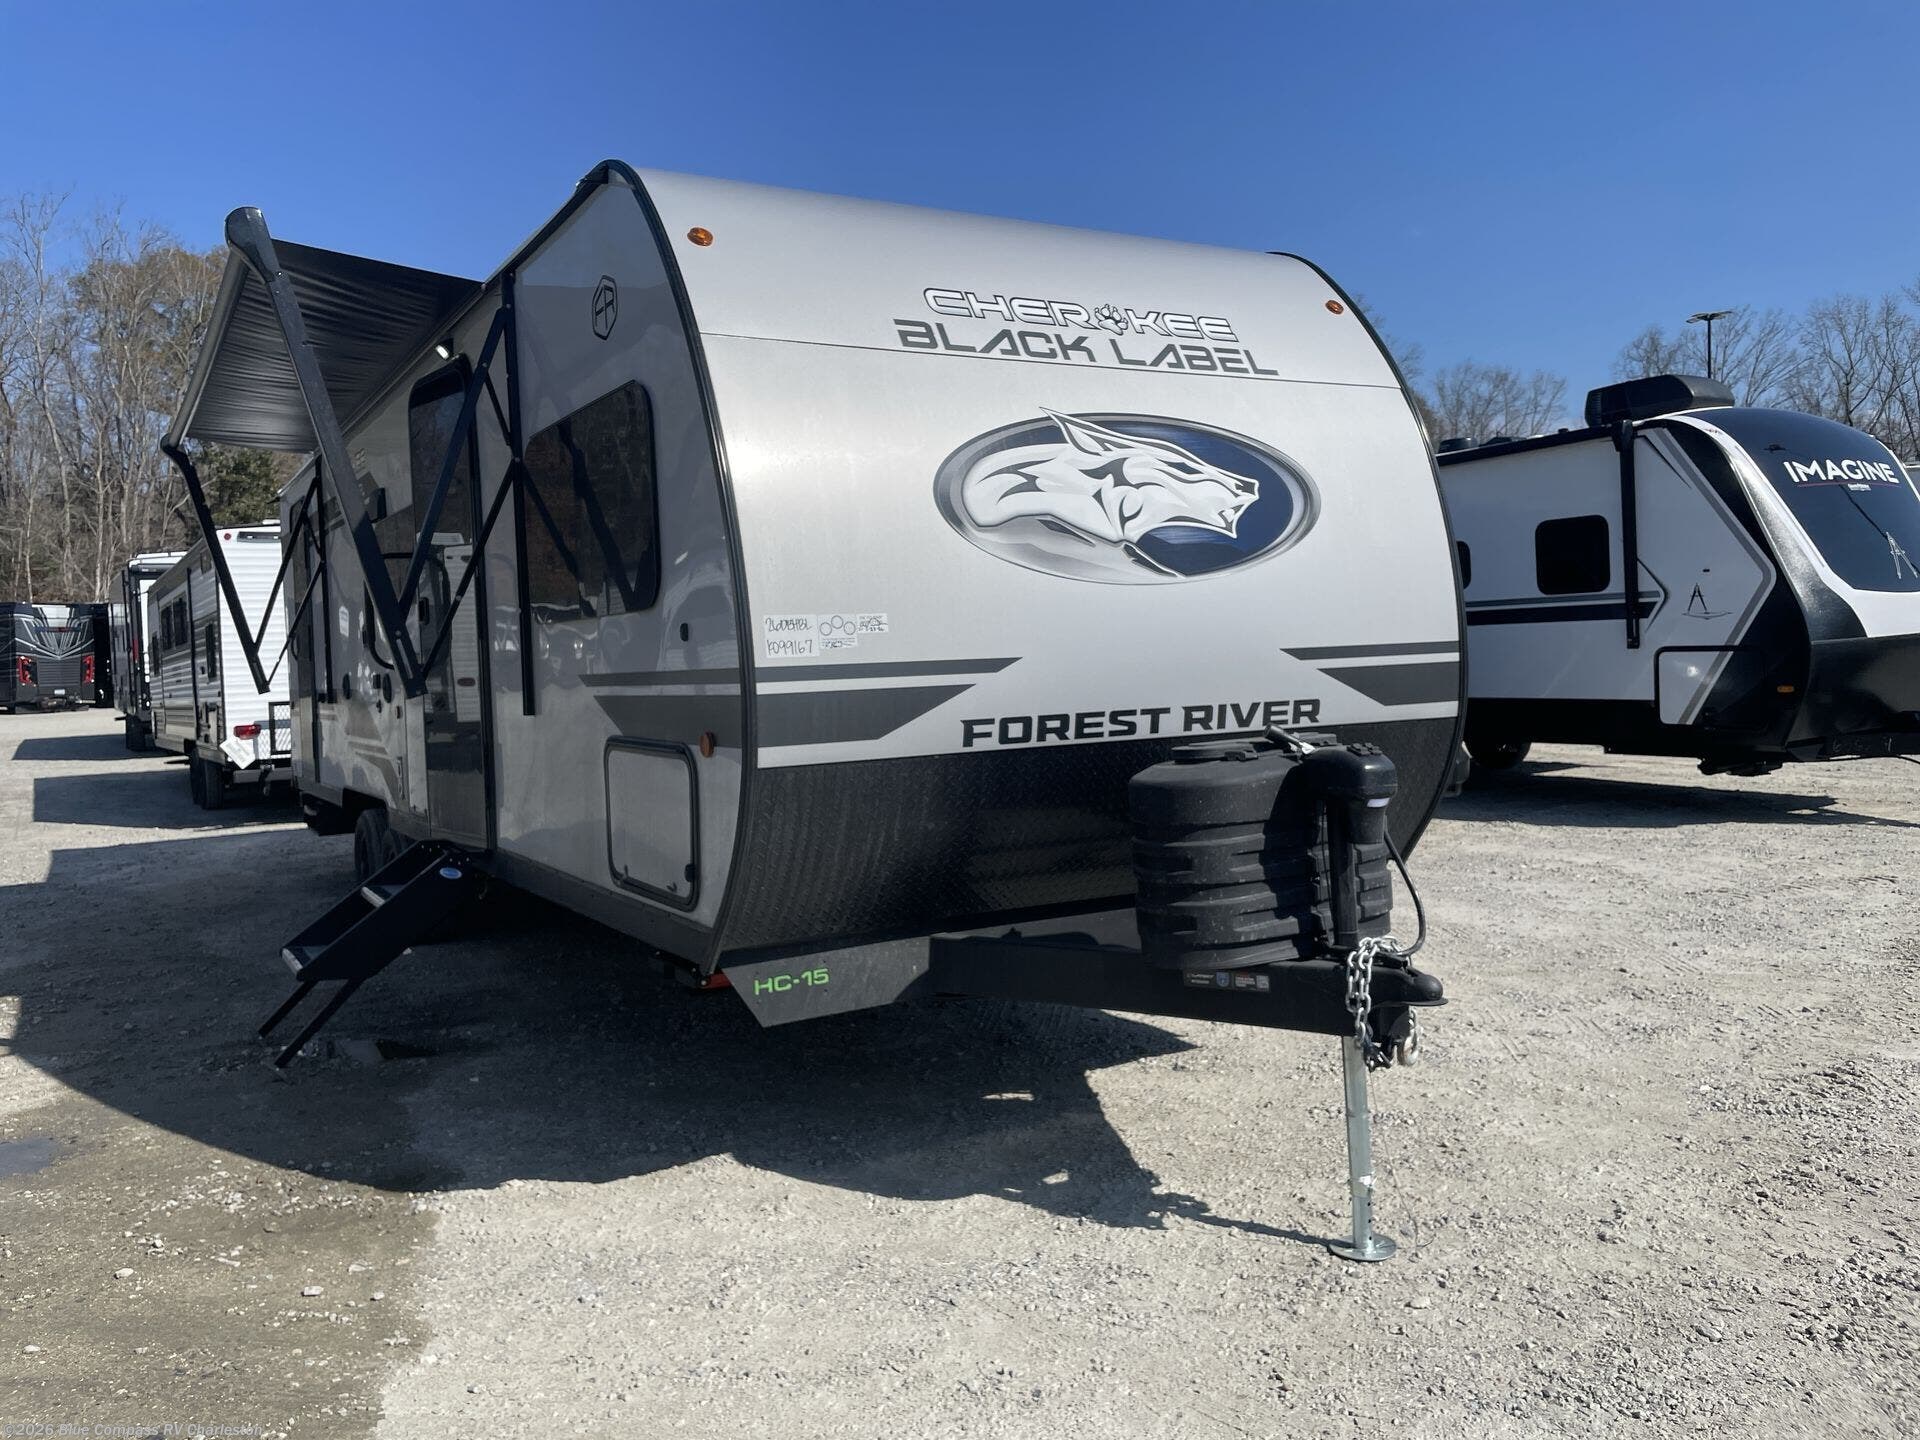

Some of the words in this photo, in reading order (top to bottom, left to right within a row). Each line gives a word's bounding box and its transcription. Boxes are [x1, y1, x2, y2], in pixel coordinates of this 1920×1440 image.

[893, 318, 1097, 363] BLACK
[1109, 338, 1280, 376] LABEL
[1783, 459, 1900, 484] IMAGINE
[960, 707, 1171, 748] FOREST
[1181, 698, 1321, 732] RIVER
[754, 968, 830, 996] HC-15
